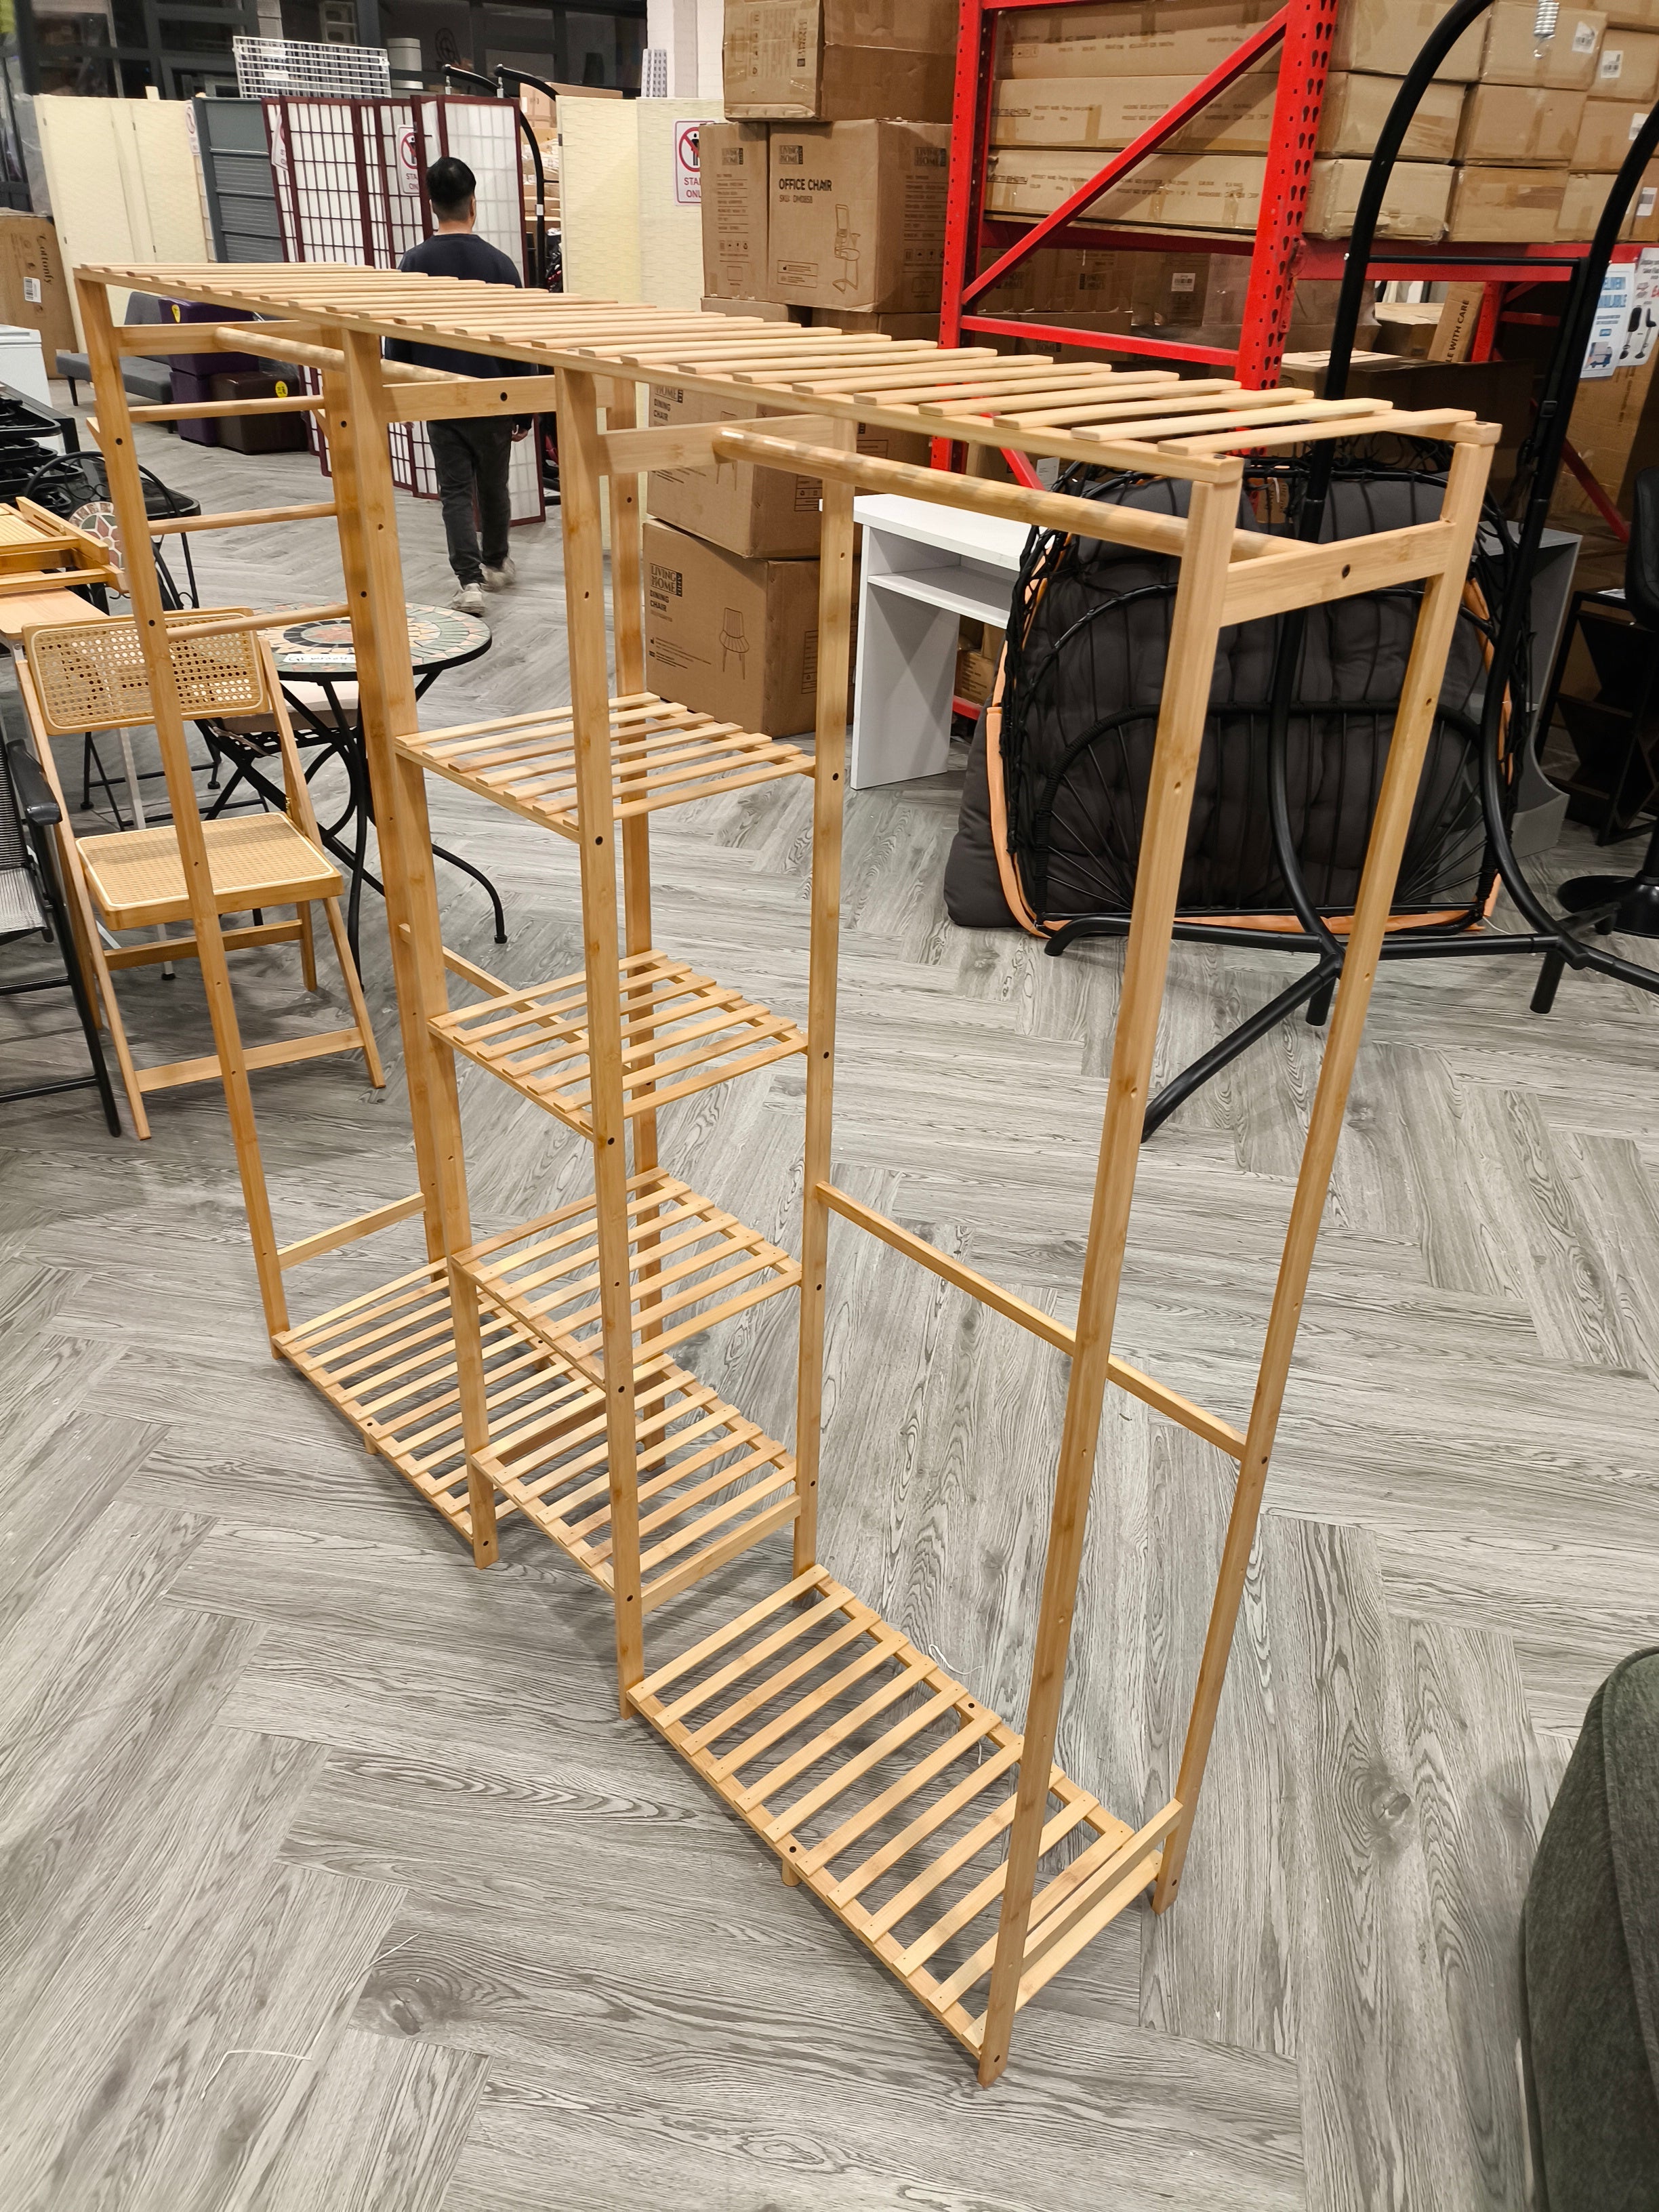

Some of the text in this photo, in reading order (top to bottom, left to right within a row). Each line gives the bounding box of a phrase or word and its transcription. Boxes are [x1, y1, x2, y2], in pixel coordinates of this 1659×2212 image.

[684, 177, 701, 186] STA
[779, 178, 832, 192] OFFICE CHAIR
[686, 189, 701, 198] ONL
[1449, 325, 1462, 350] WITH
[1457, 300, 1469, 324] CARE
[651, 565, 676, 582] LIVING
[651, 575, 676, 594] HOME
[650, 589, 670, 604] DINING
[650, 600, 667, 613] CHAIR
